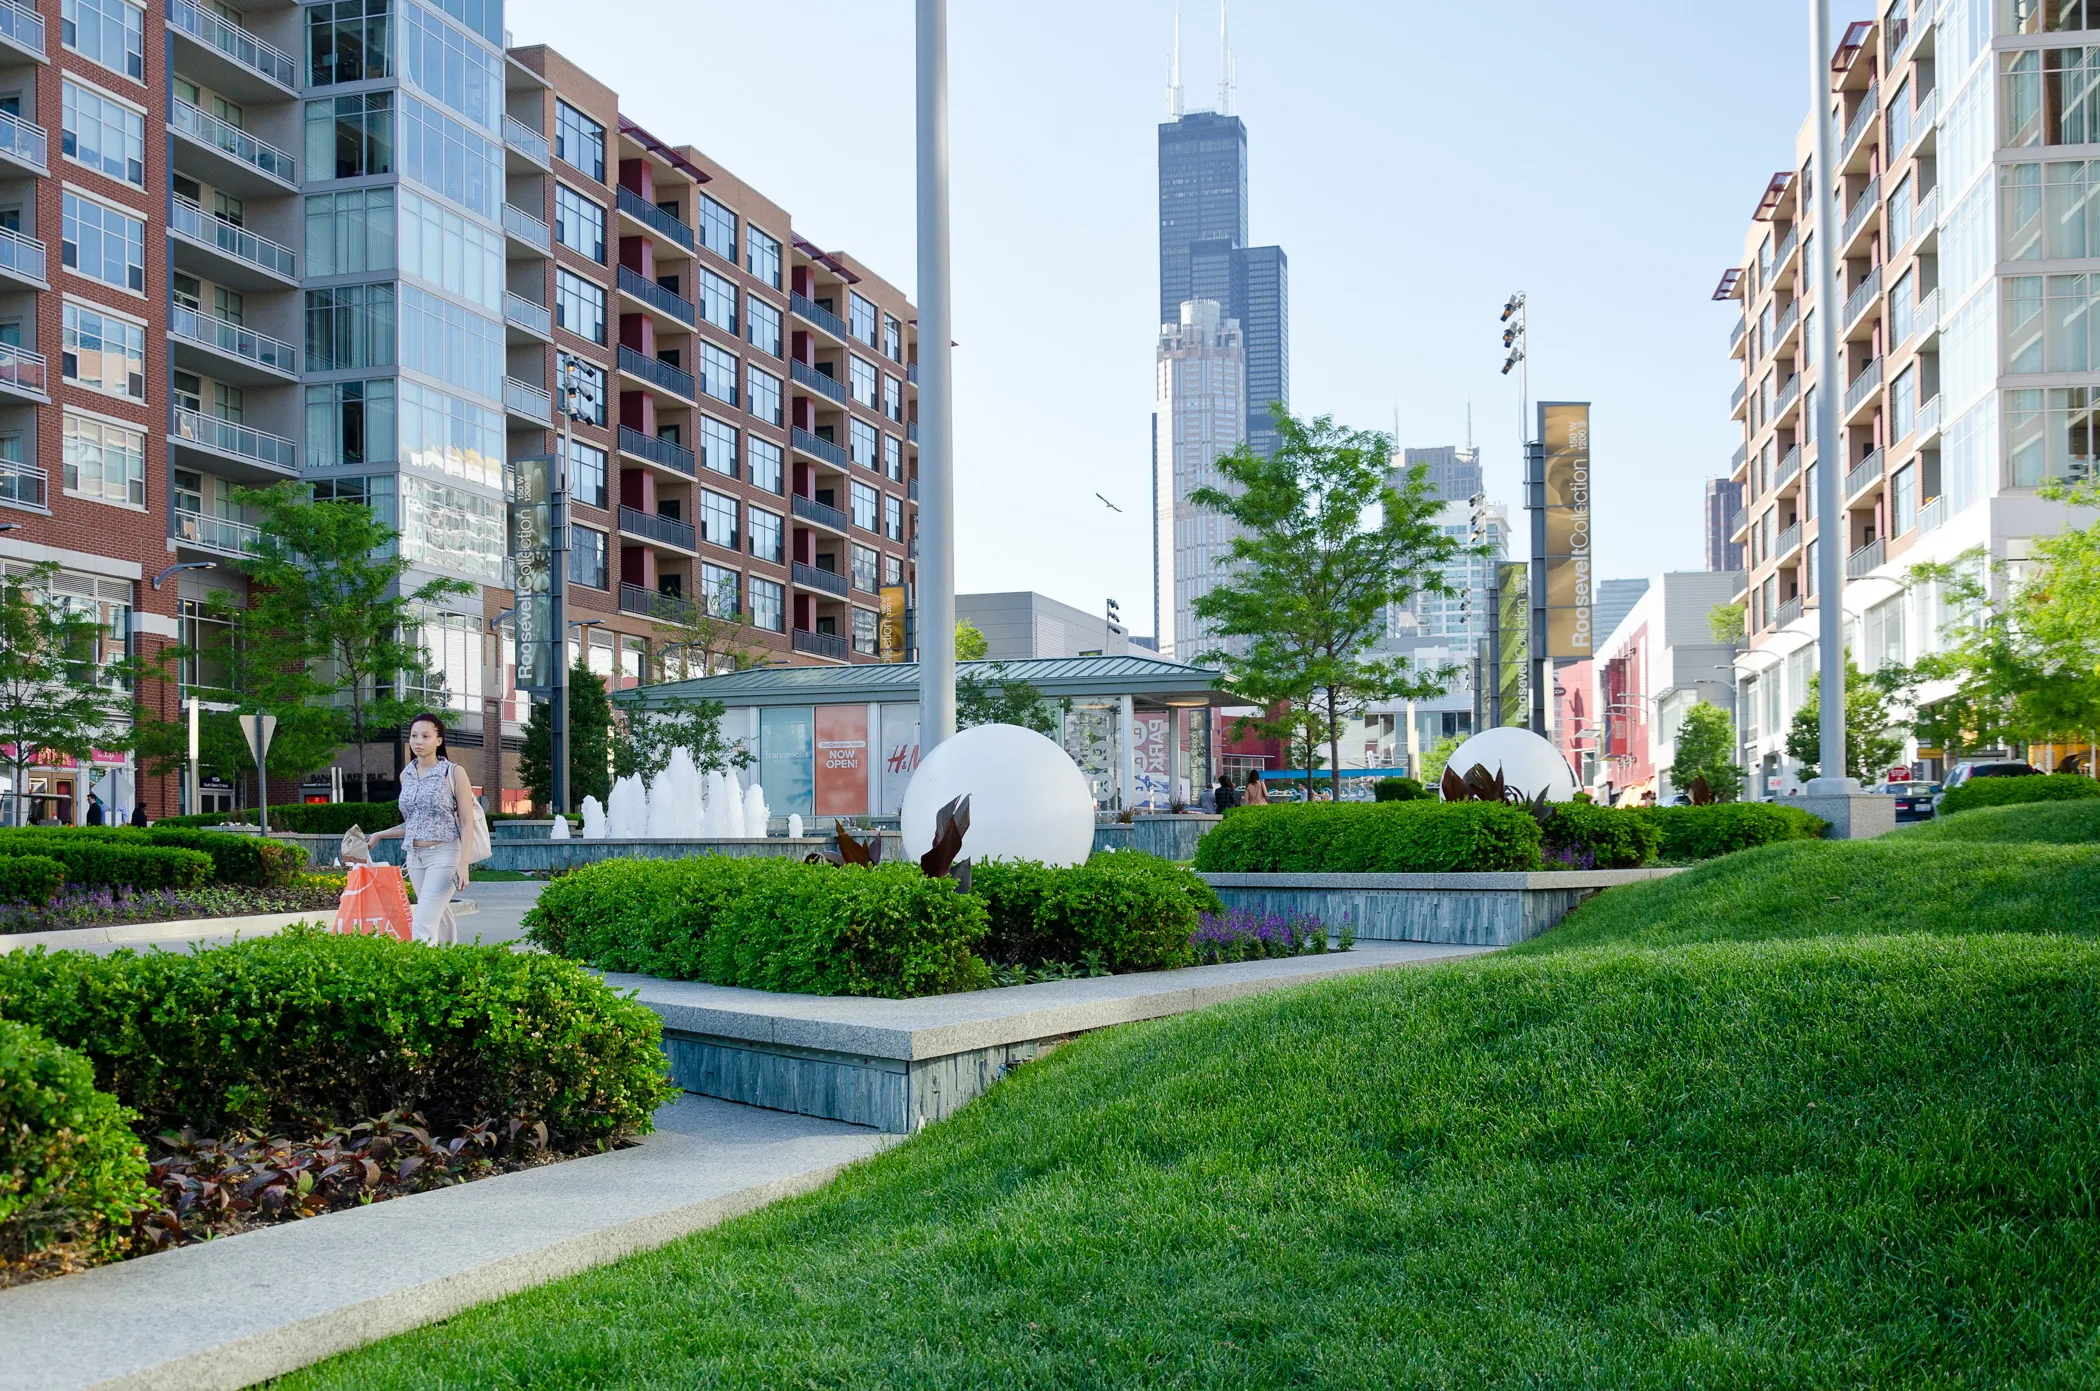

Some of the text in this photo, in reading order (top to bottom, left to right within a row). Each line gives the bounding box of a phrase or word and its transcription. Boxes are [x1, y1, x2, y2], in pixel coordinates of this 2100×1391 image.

[1569, 421, 1578, 449] 150 W
[1578, 430, 1587, 451] 1200
[517, 474, 524, 485] W
[1569, 458, 1590, 648] RooseveltCollection
[517, 509, 532, 679] RooseveltCollection
[881, 620, 892, 664] ollection
[1515, 599, 1528, 723] RooseveltCollection
[765, 749, 811, 760] francesca's
[829, 750, 855, 759] NOW
[826, 760, 858, 769] OPEN!
[311, 772, 388, 782] BANAA REPBLIC
[1890, 769, 1907, 777] STOP
